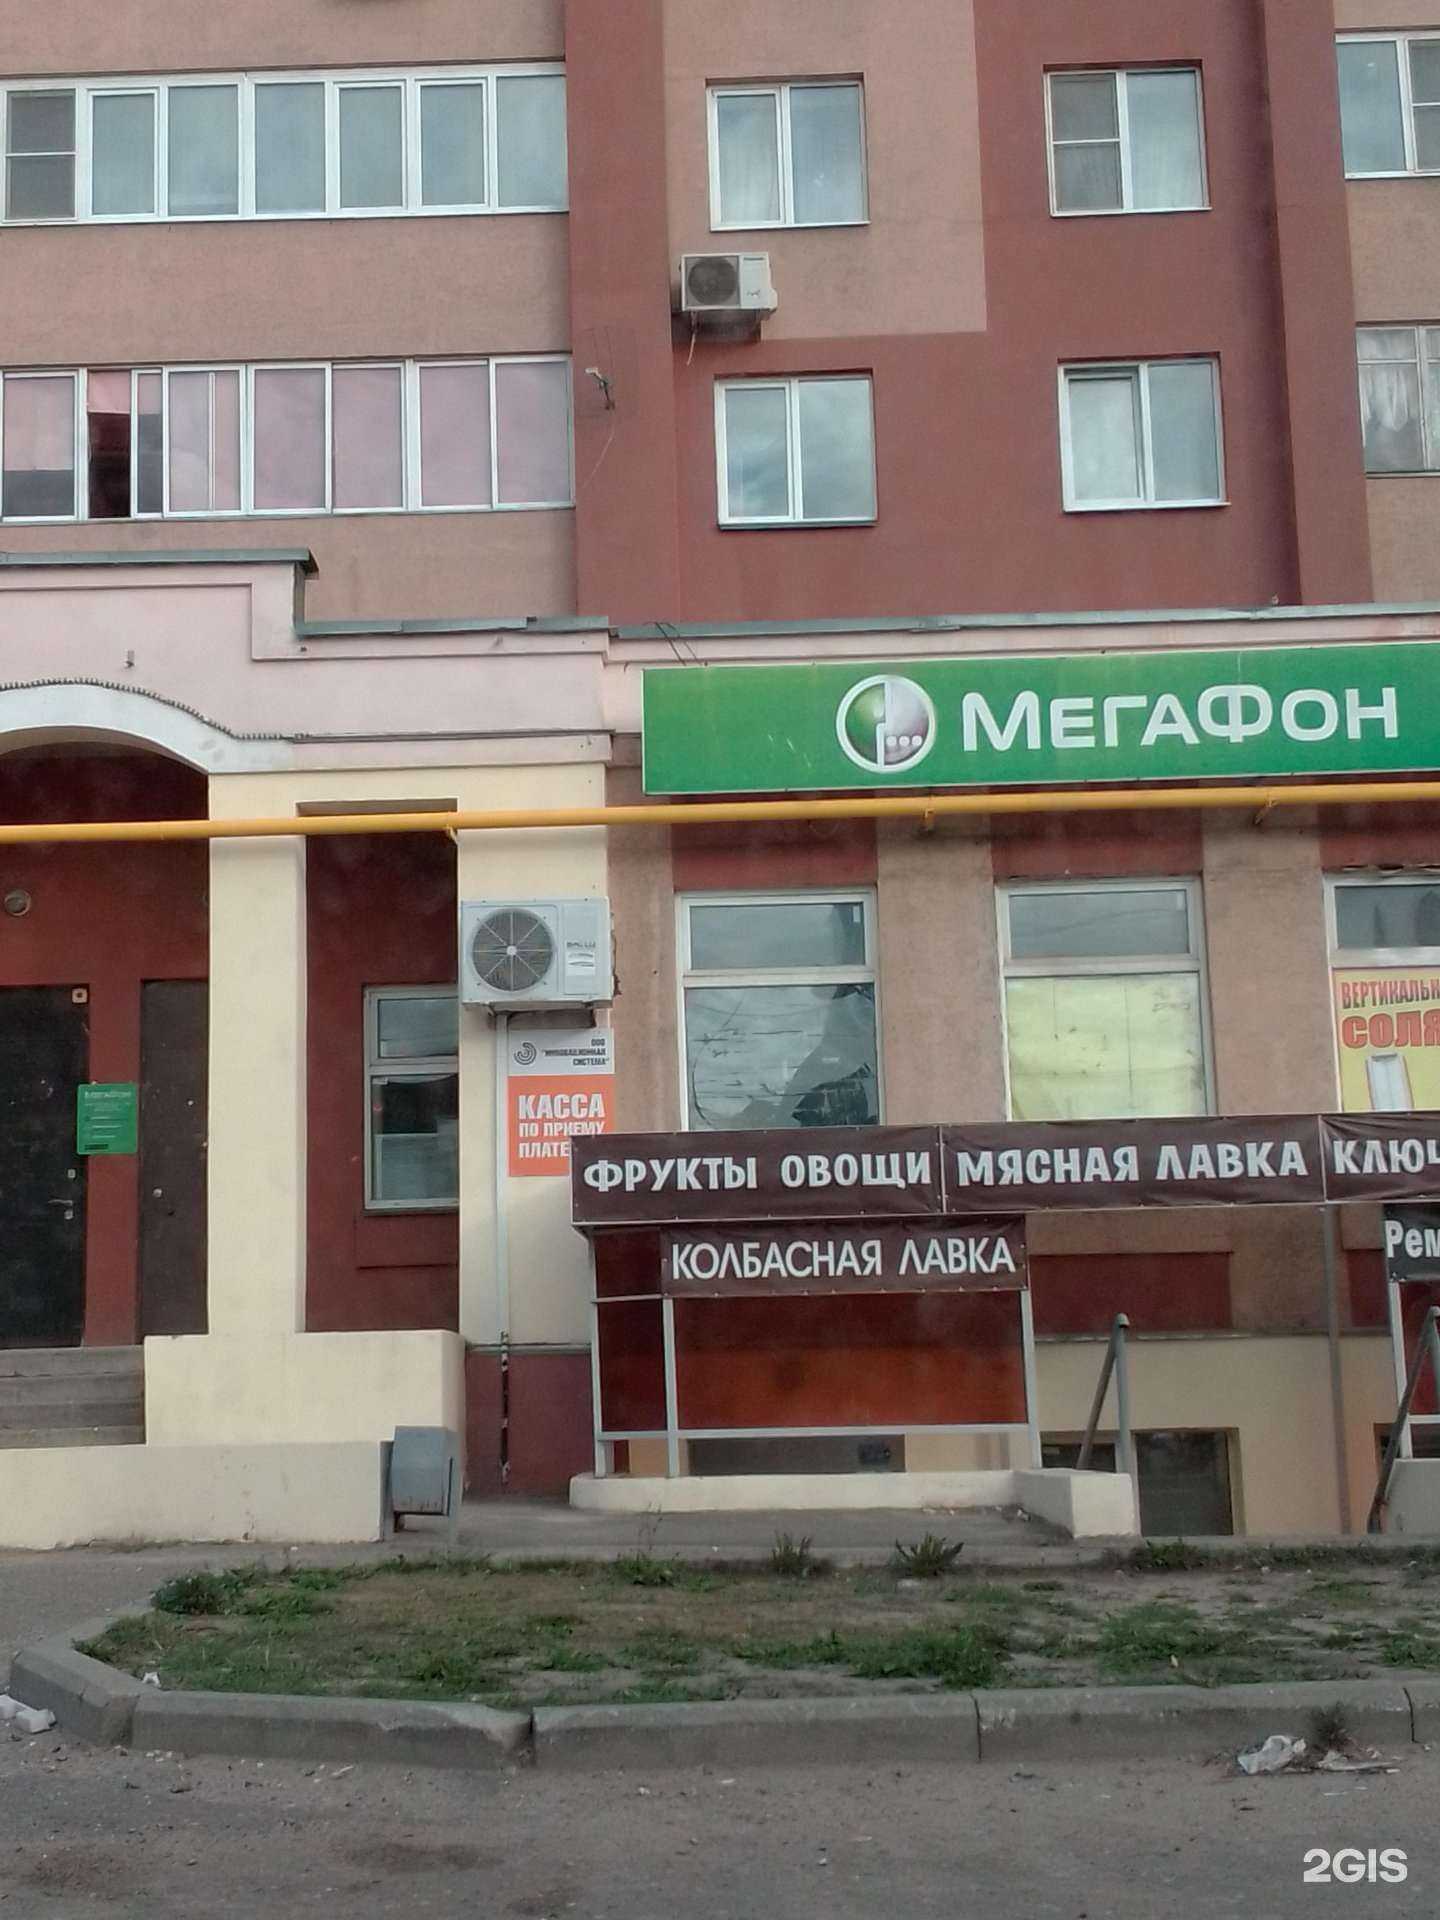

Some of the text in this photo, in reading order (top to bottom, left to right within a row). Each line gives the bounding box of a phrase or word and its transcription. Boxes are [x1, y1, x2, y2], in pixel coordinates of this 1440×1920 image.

[518, 1093, 606, 1119] КАССА
[519, 1121, 605, 1138] ПО ПРИЕМУ
[583, 1151, 931, 1193] ФРУКТЫ ОВОЩИ
[956, 1141, 1309, 1186] МЯСНАЯ ЛАВКА
[671, 1236, 1017, 1280] КОЛБАСНАЯ ЛАВКА
